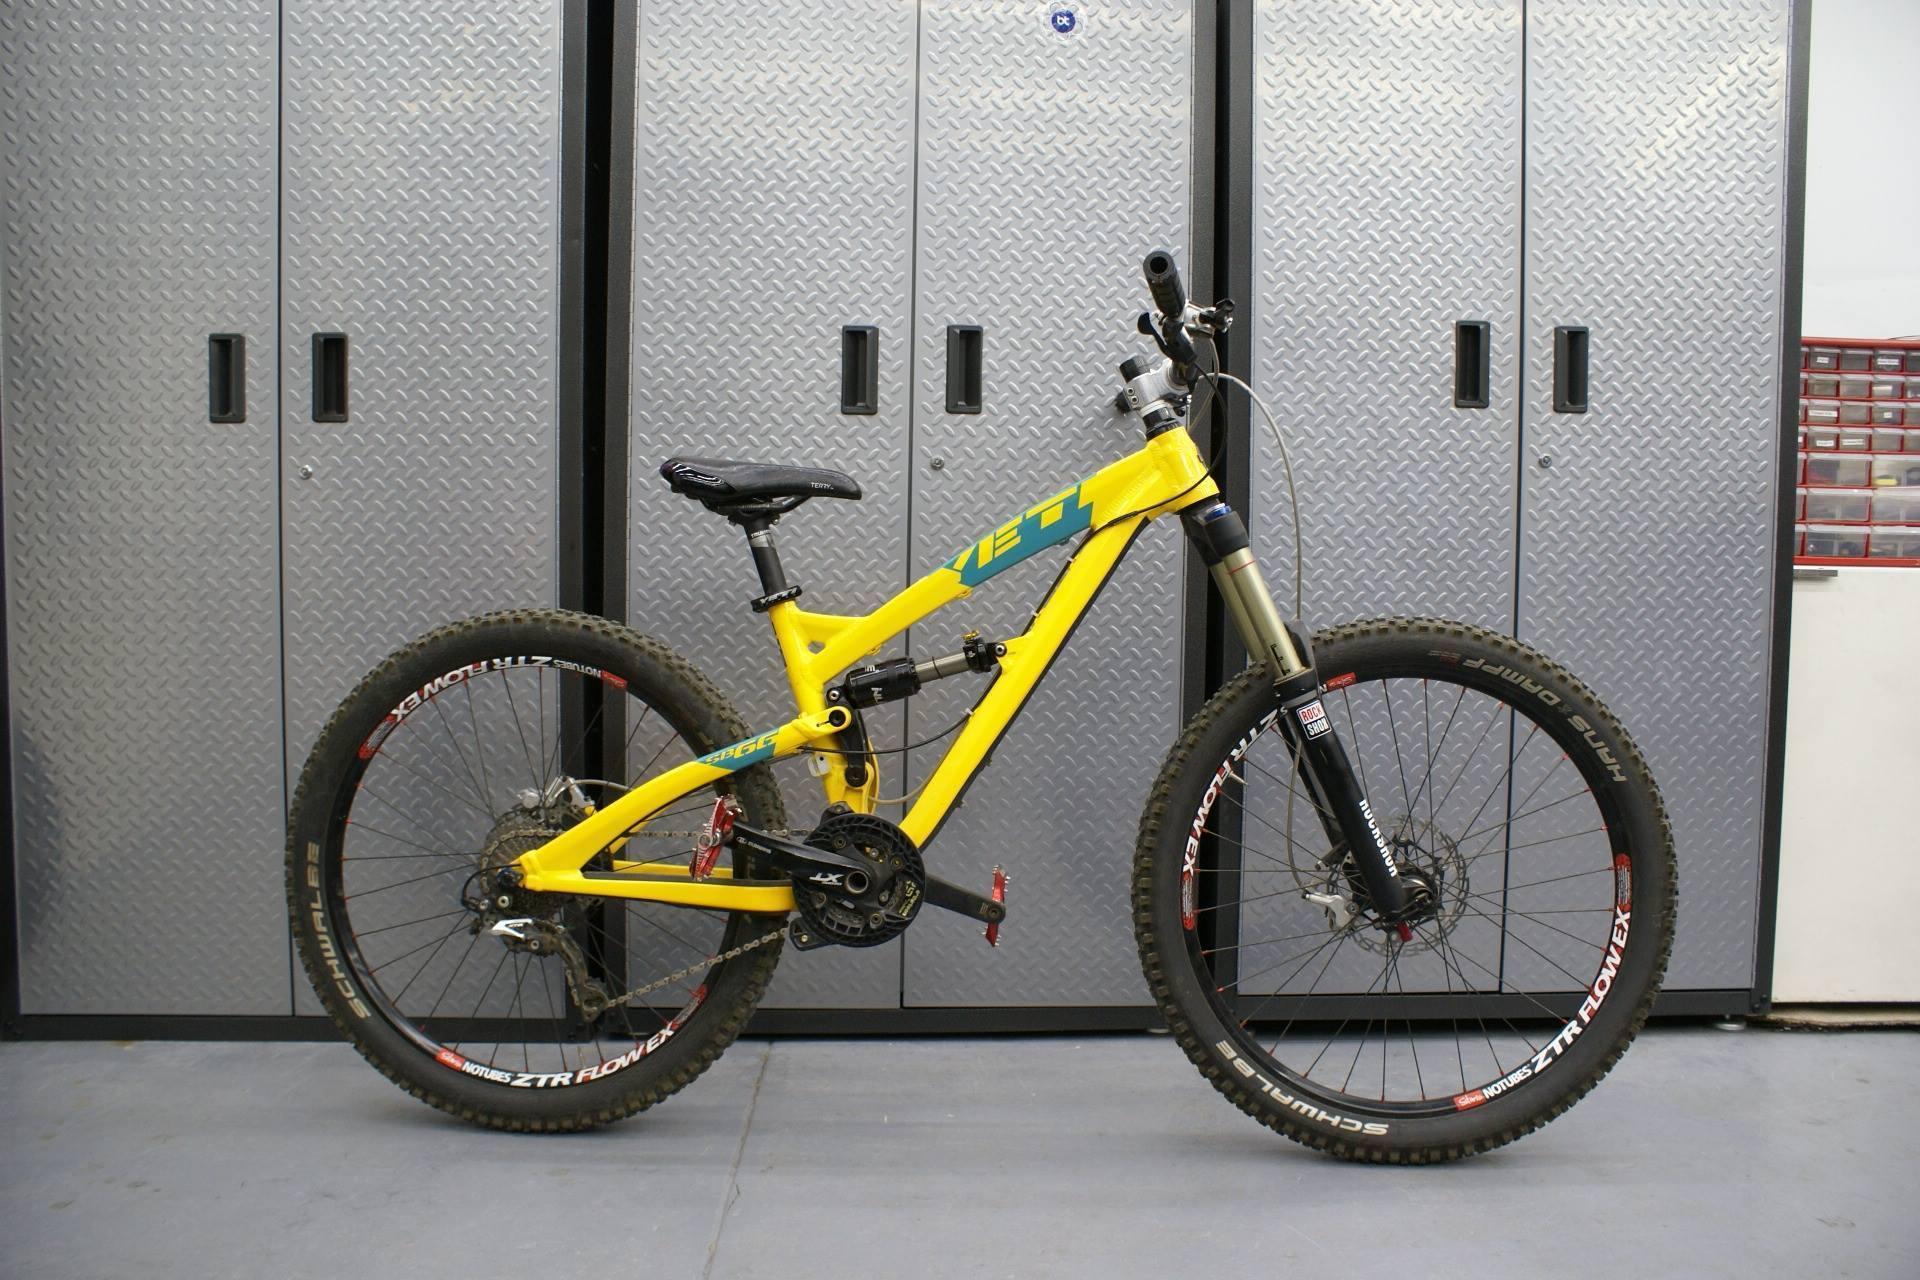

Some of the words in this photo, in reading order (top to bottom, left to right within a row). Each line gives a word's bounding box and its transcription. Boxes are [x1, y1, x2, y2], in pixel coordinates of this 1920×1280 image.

[423, 661, 488, 699] FLOW
[493, 655, 552, 670] ZTR
[553, 659, 603, 678] NOTUBES
[1462, 658, 1561, 706] DAMPF
[390, 691, 422, 722] EX
[1301, 705, 1323, 722] ROCK
[1307, 717, 1329, 736] SHOX
[1567, 715, 1628, 782] HANS
[307, 841, 371, 1019] SCHWALBE
[1482, 1063, 1532, 1099] NOTUBES
[1531, 1020, 1583, 1074] ZTR
[1578, 947, 1622, 1023] FLOW
[1613, 906, 1631, 949] EX
[462, 1062, 512, 1083] NOTUBES
[510, 1072, 573, 1088] ZTR
[575, 1044, 645, 1083] FLOW
[646, 1021, 675, 1053] EX
[1216, 1040, 1389, 1136] SCHWALBE
